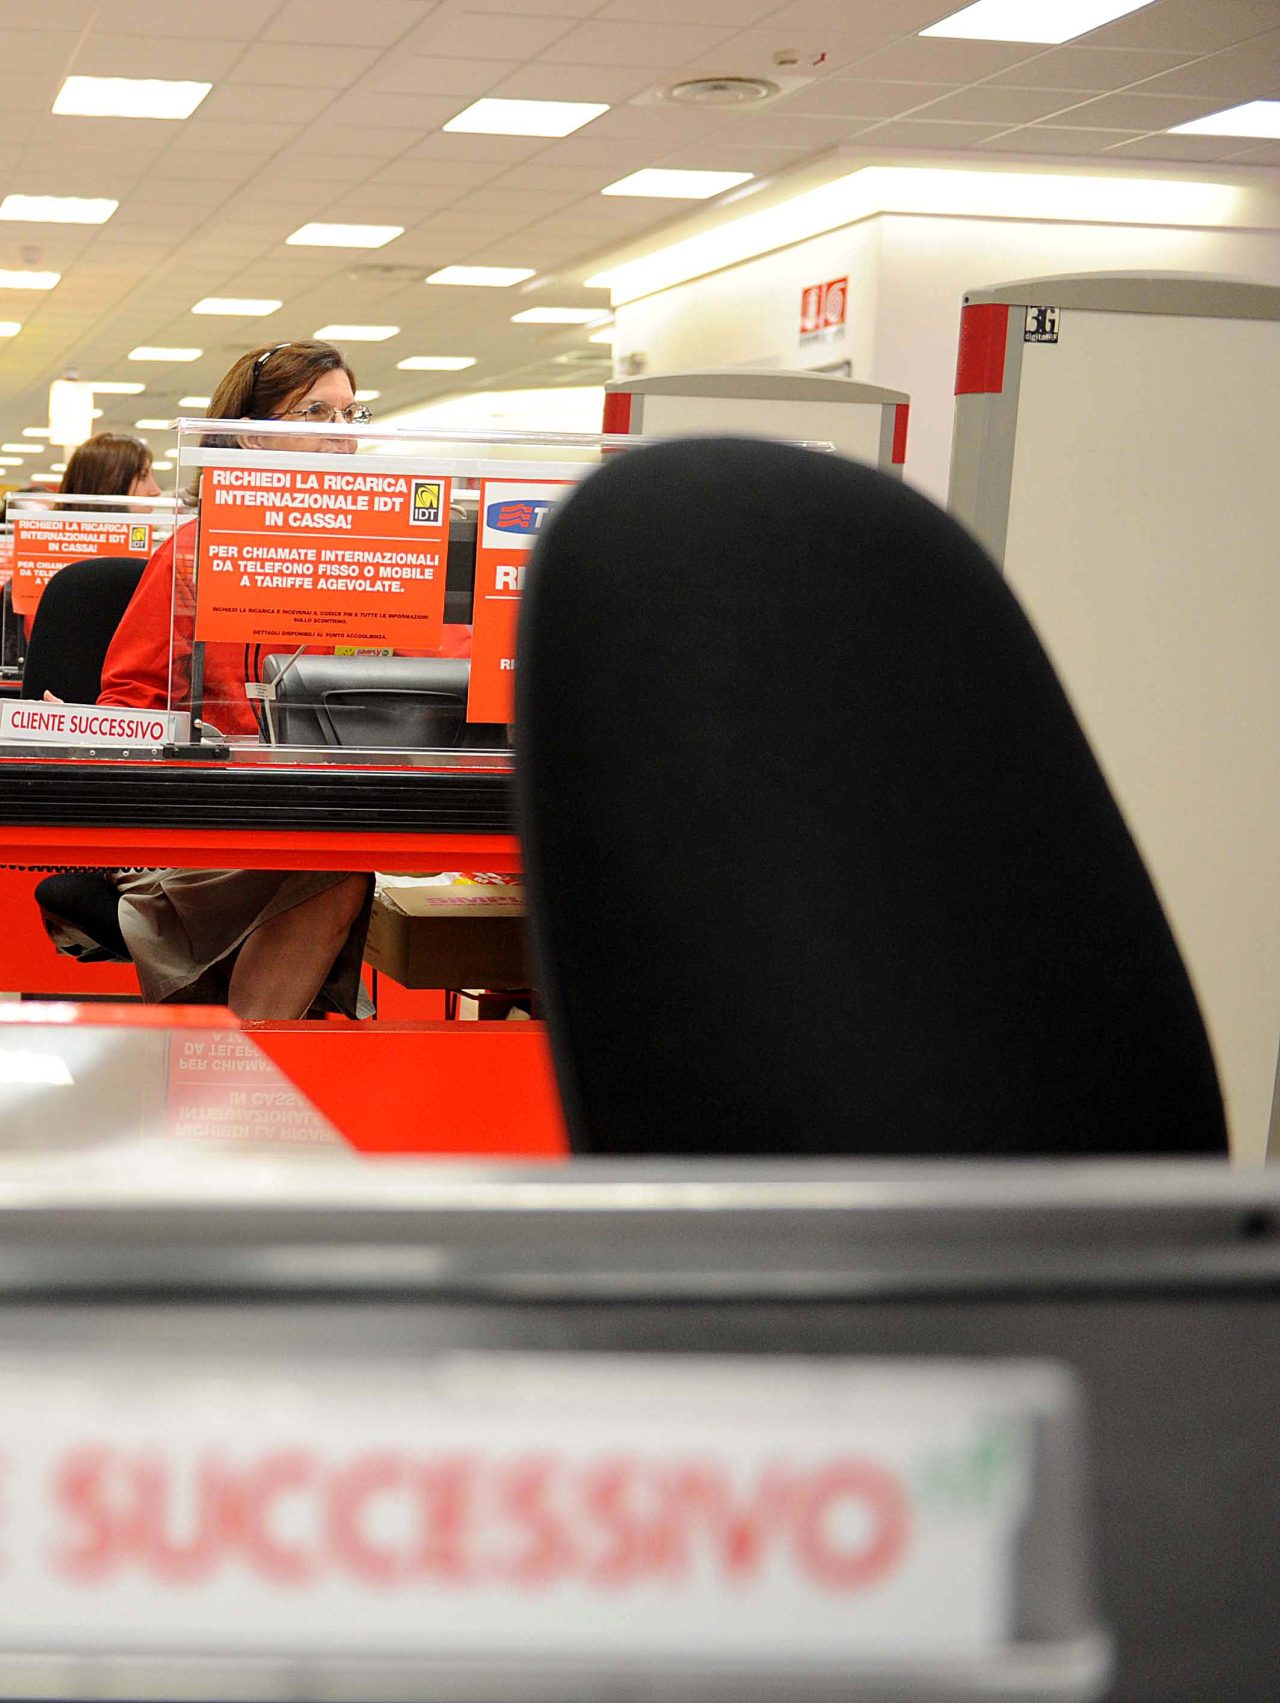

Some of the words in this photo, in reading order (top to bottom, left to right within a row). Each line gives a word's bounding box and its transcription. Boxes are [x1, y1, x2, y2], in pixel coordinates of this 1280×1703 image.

[213, 470, 291, 488] RICHIEDI
[296, 474, 319, 489] LA
[323, 475, 408, 493] RICARICA
[215, 490, 369, 511] INTERNAZIONALE
[373, 497, 404, 512] IDT
[265, 512, 283, 526] IN
[288, 512, 353, 529] CASSA!
[414, 508, 437, 521] IDT
[19, 520, 63, 530] RICHIEDI
[66, 522, 78, 531] LA
[81, 523, 128, 533] RICARICA
[20, 530, 107, 543] INTERNAZIONALE
[109, 534, 126, 543] IDT
[48, 542, 59, 552] IN
[62, 543, 98, 553] CASSA!
[209, 545, 238, 558] PER
[242, 546, 317, 561] CHIAMATE
[321, 549, 440, 566] INTERNAZIONALI
[17, 561, 35, 569] PER
[20, 569, 32, 577] DA
[212, 559, 233, 572] DA
[238, 560, 314, 575] TELEFONO
[318, 563, 359, 577] FISSO
[363, 565, 374, 577] O
[379, 566, 433, 580] MOBILE
[240, 575, 251, 587] A
[255, 576, 313, 589] TARIFFE
[317, 577, 405, 593] AGEVOLATE.
[11, 710, 65, 732] CLIENTE
[69, 714, 163, 741] SUCCESSIVO
[58, 1440, 912, 1595] SUCCESSIVO
